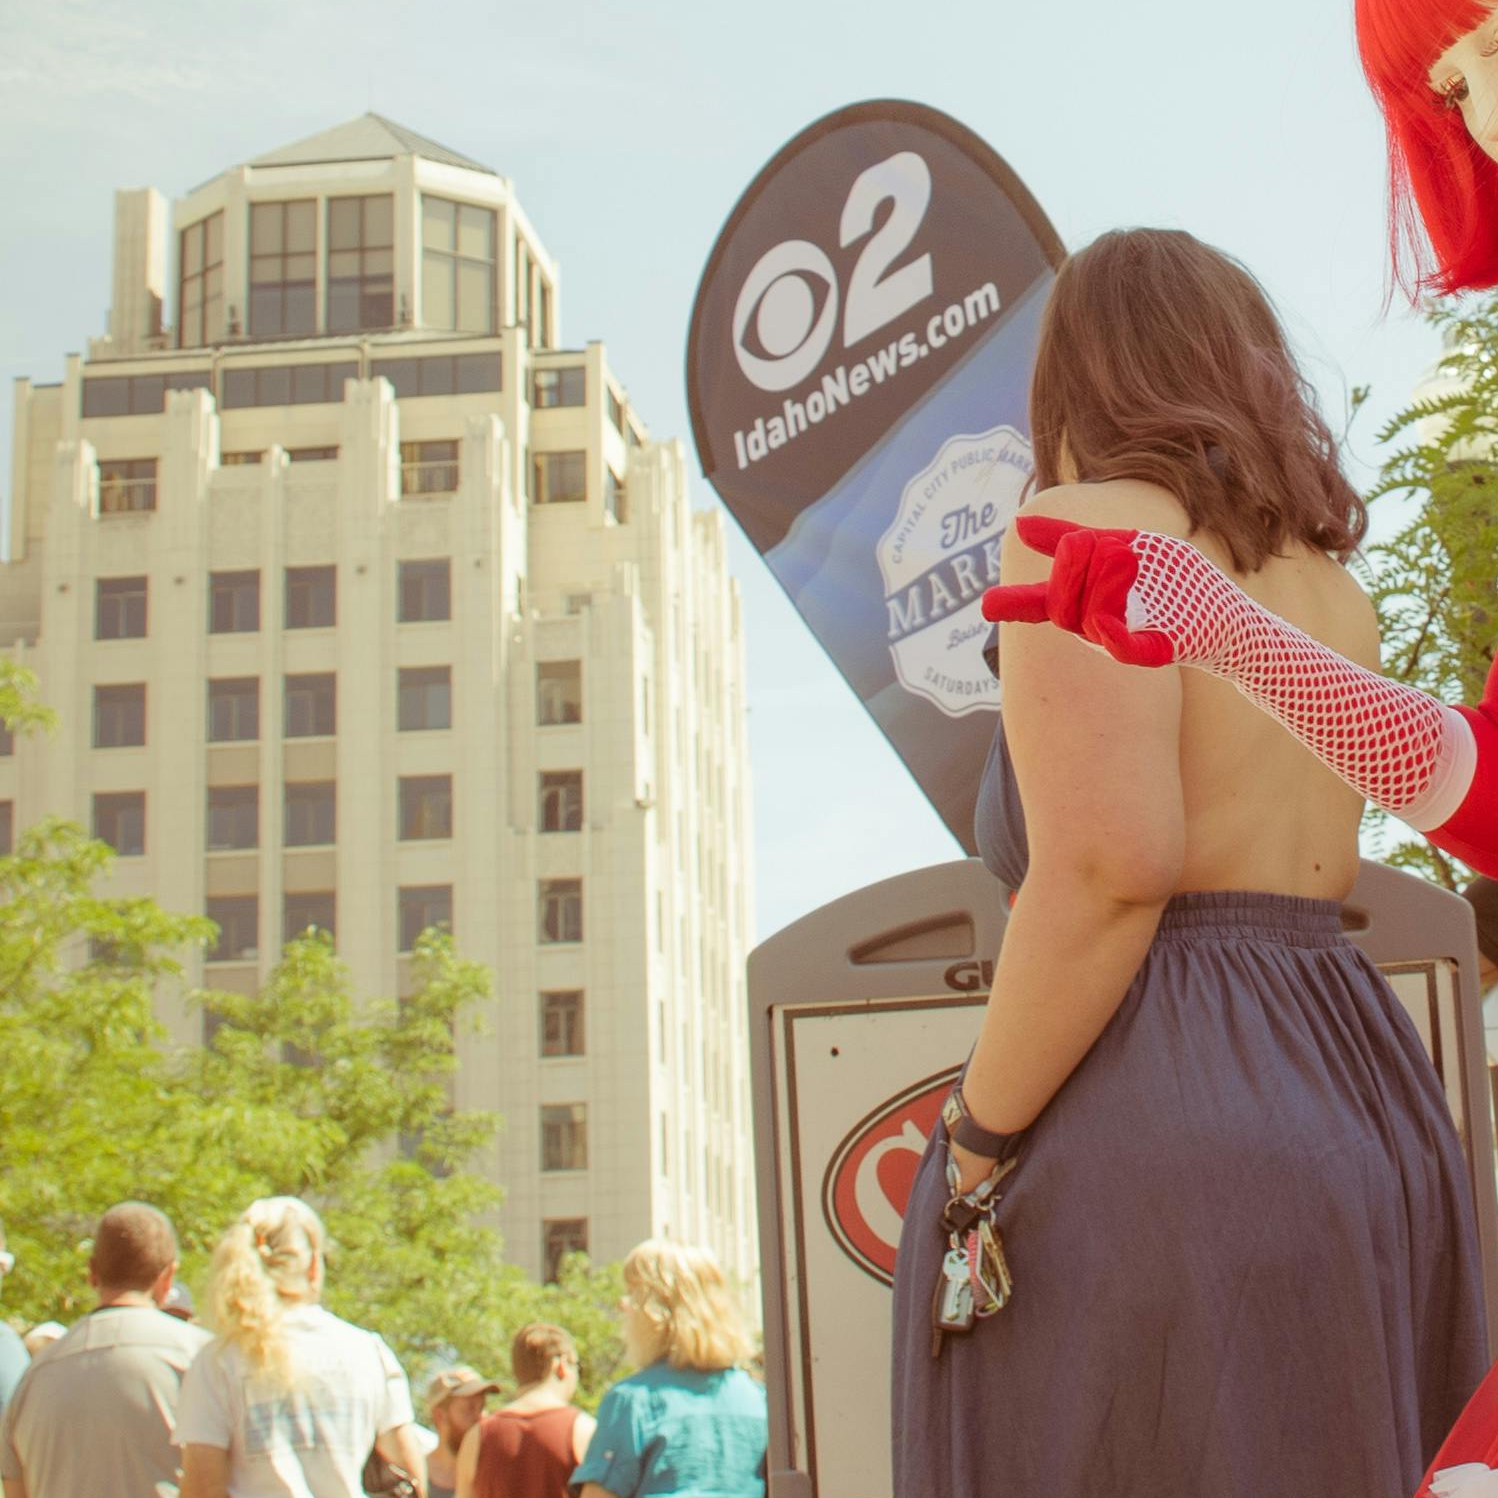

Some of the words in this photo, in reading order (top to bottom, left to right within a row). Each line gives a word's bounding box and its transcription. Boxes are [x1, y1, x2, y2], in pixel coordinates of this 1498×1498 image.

[839, 151, 933, 349] 2
[733, 281, 1001, 470] IdahoNews.com
[892, 502, 927, 565] CAPITAL
[923, 469, 950, 500] CITY
[950, 447, 996, 475] PUBLIC
[997, 449, 1033, 474] MARK
[940, 502, 998, 549] The
[886, 541, 1001, 639] MARK
